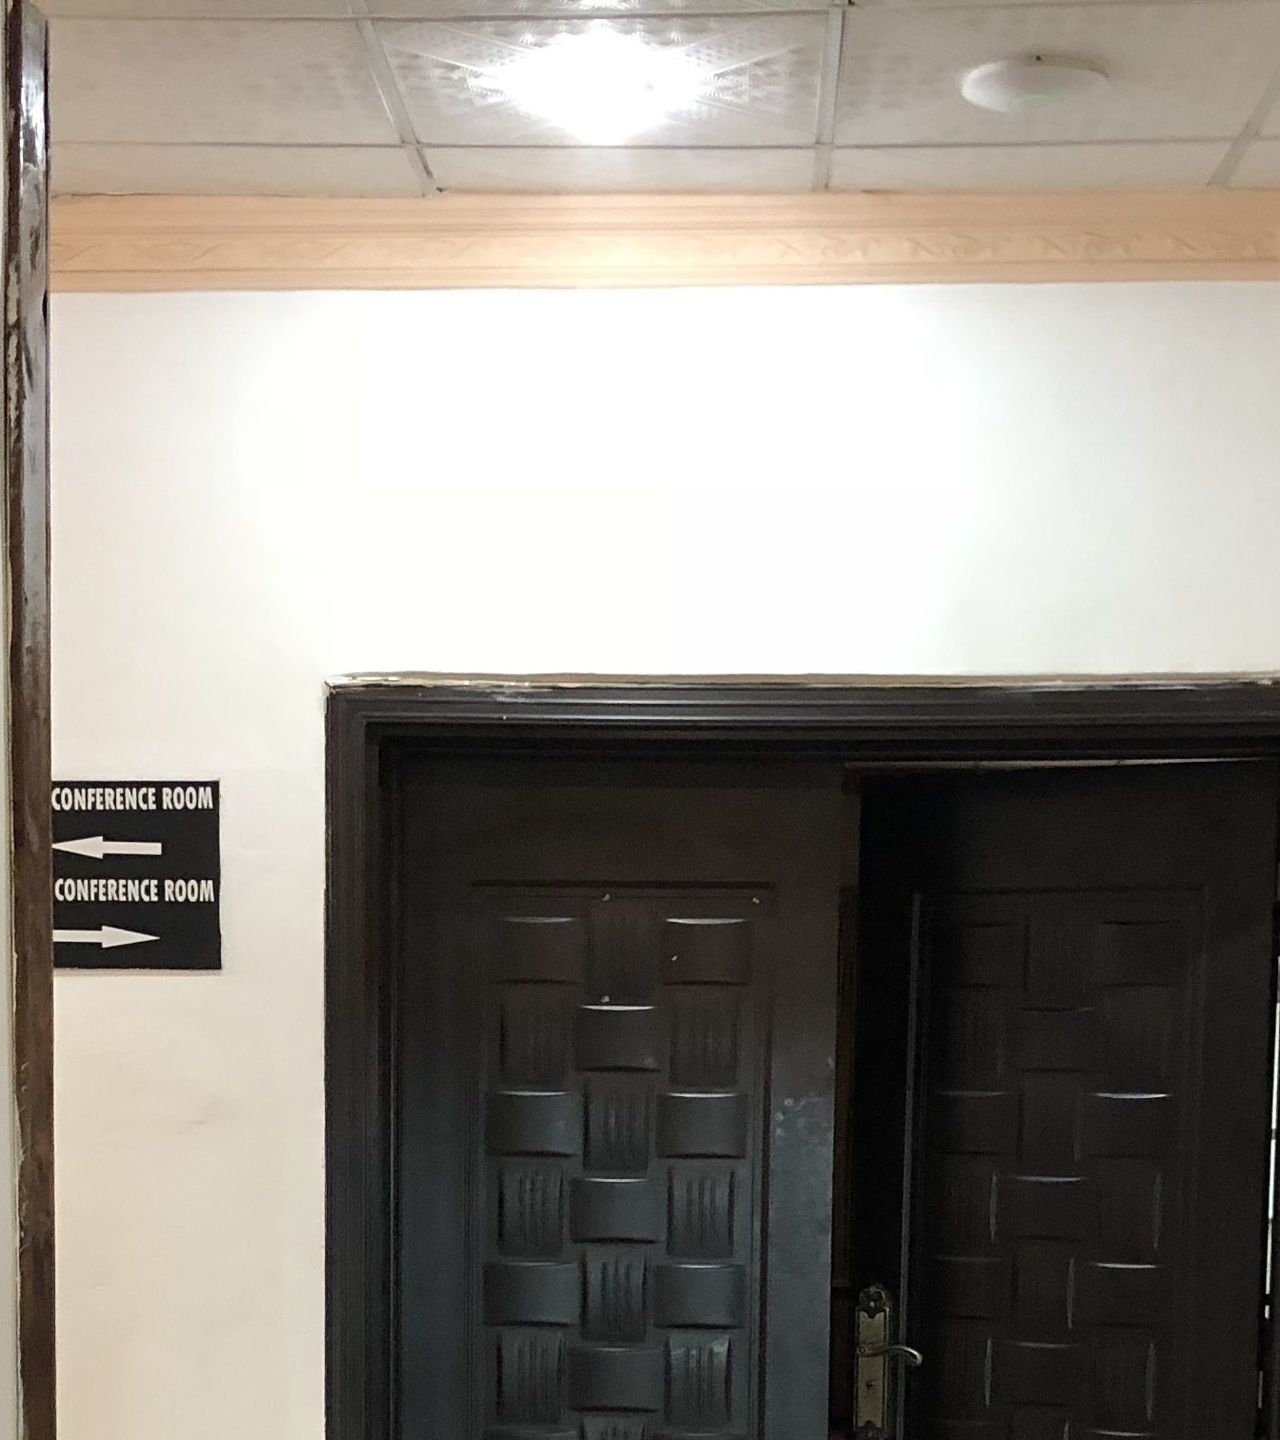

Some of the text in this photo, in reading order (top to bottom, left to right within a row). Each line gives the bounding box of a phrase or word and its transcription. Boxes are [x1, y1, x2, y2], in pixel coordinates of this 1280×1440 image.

[51, 786, 214, 811] CONFERENCE ROOM
[54, 878, 215, 902] CONFERENCE ROOM
